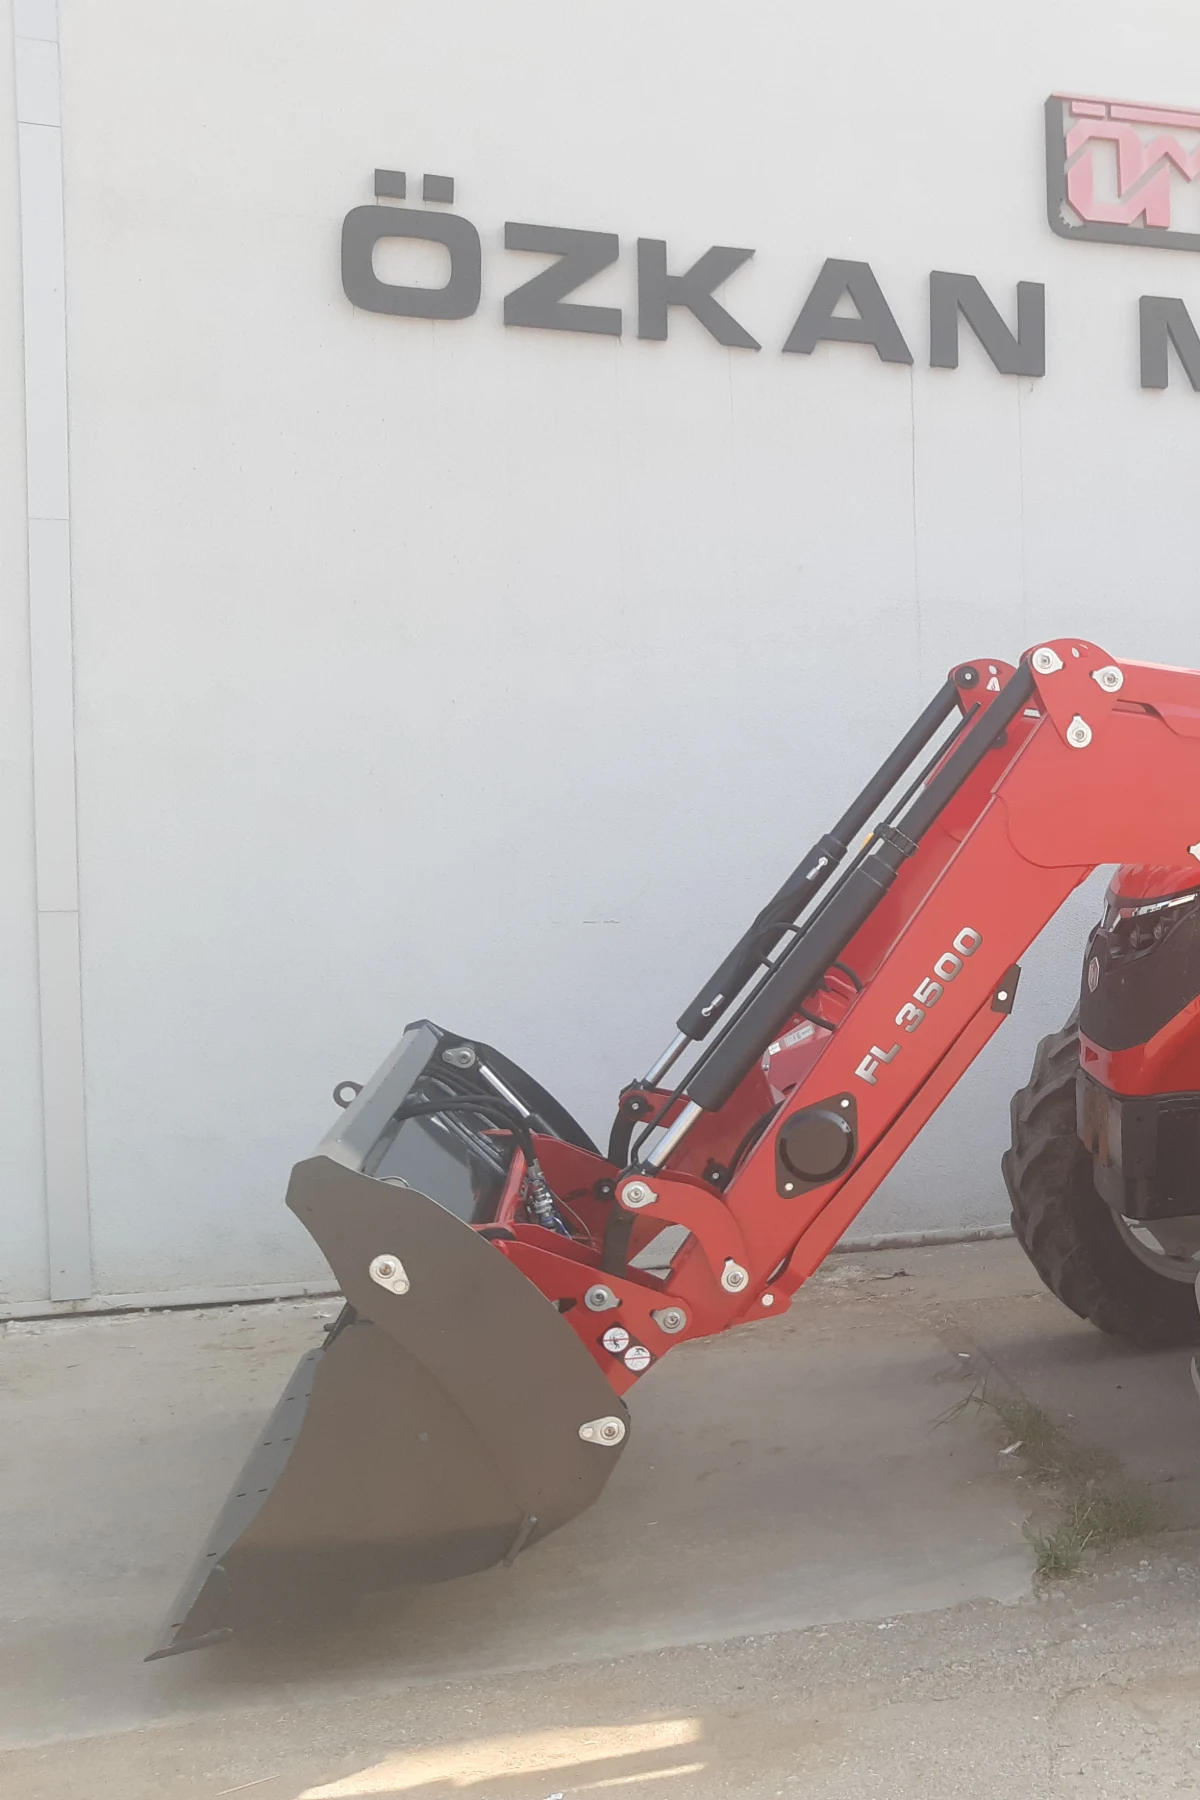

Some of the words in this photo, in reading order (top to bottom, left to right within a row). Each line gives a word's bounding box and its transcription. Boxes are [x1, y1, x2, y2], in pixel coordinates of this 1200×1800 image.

[341, 168, 1046, 378] ÖZKAN
[854, 1043, 902, 1086] FL
[894, 926, 983, 1033] 3500
